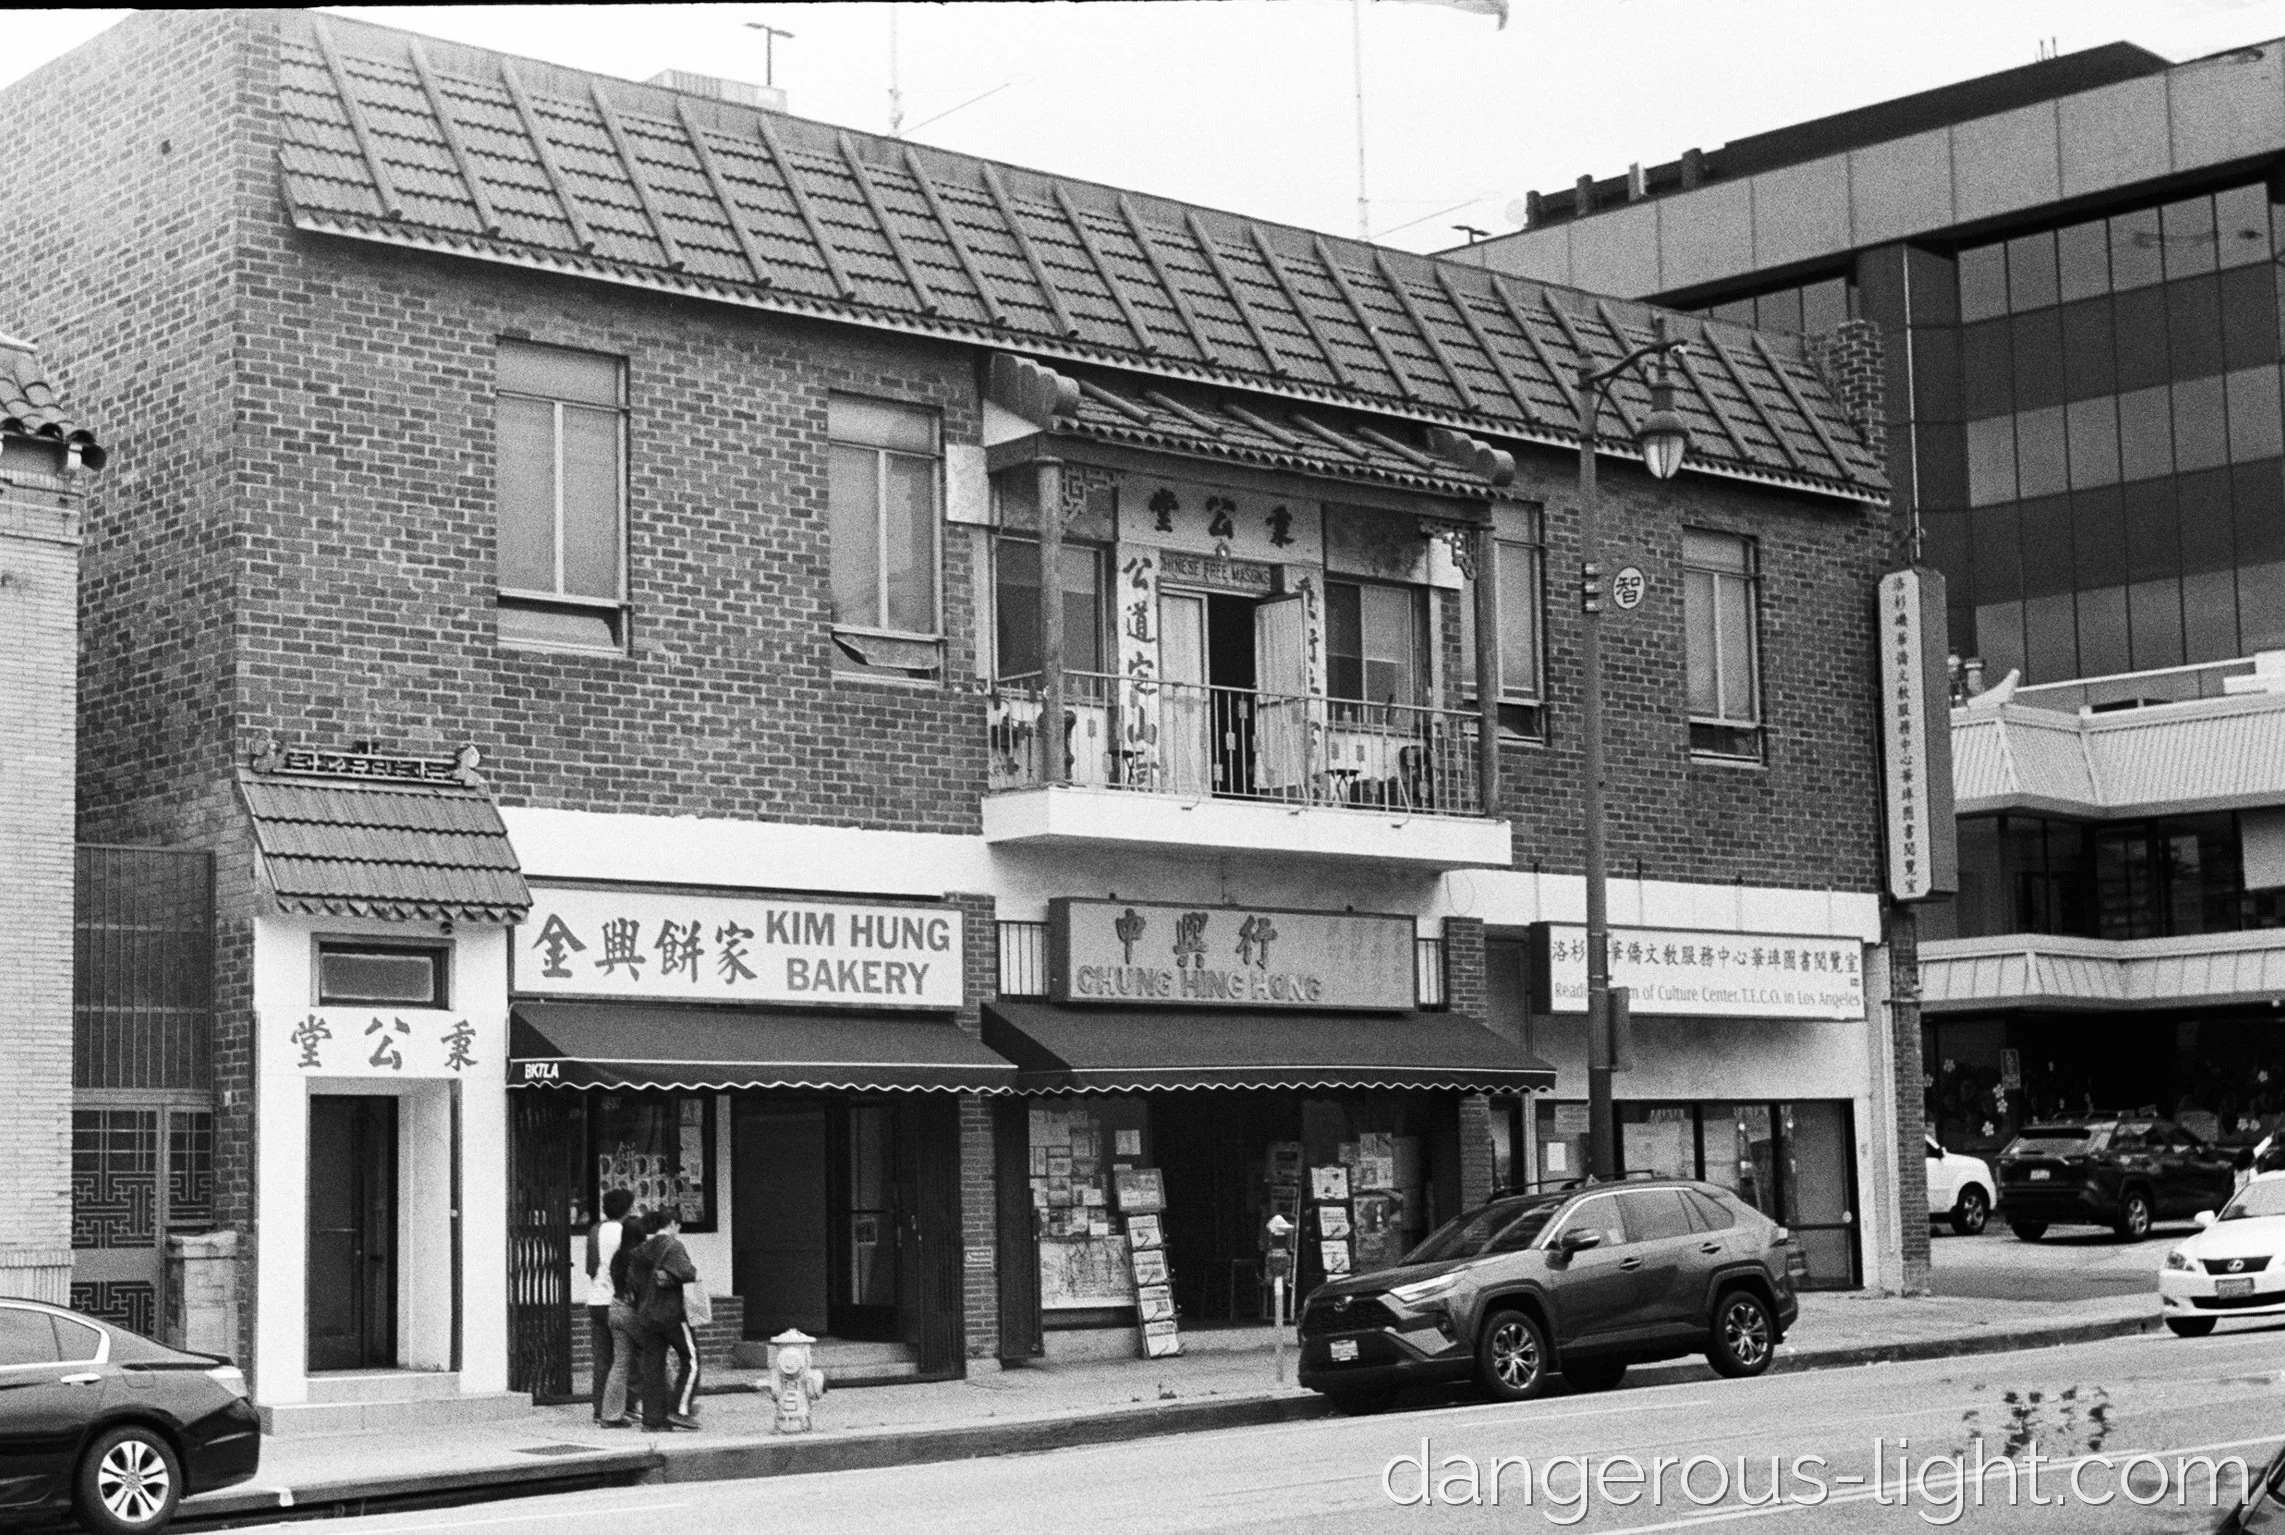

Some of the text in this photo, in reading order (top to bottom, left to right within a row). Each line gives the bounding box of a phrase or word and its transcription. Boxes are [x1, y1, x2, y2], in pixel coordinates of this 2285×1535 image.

[1615, 576, 1641, 603] 智
[531, 912, 759, 985] 金興餅家
[766, 909, 951, 952] KIM HUNG
[786, 957, 931, 996] BAKERY
[1077, 964, 1323, 1001] CHUNG HING HONG
[1643, 985, 1654, 1000] of
[1658, 985, 1699, 1001] Culture
[1784, 991, 1794, 1004] in
[1797, 990, 1815, 1005] Los
[1819, 991, 1860, 1008] Angeles
